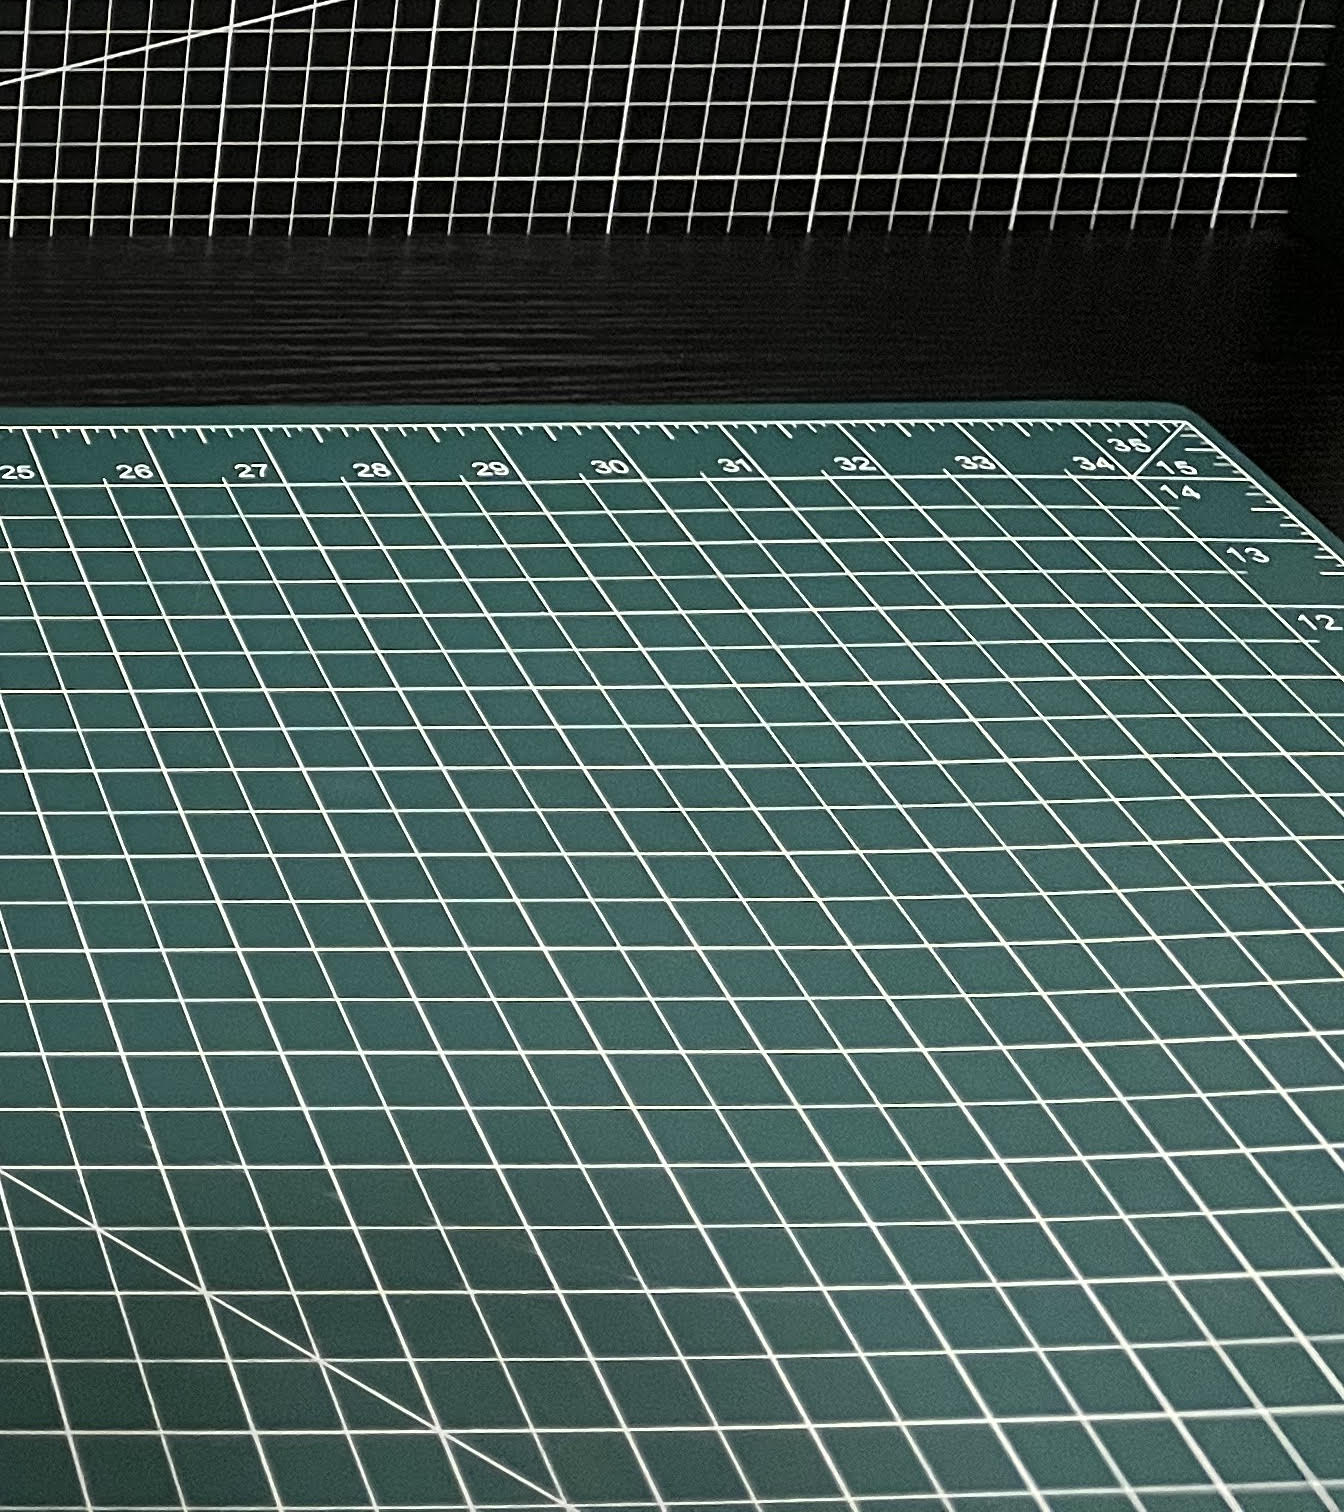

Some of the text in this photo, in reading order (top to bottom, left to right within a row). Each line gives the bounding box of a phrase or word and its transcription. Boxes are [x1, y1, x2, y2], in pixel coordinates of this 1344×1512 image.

[1107, 438, 1152, 454] 35
[234, 463, 268, 478] 27
[352, 462, 392, 478] 28
[471, 461, 510, 476] 29
[590, 459, 630, 474] 30
[717, 458, 753, 473] 31
[833, 456, 878, 472] 32
[954, 455, 997, 471] 33
[1072, 455, 1116, 472] 34
[1155, 460, 1198, 476] 15
[115, 464, 154, 479] 26
[1160, 484, 1201, 500] 14
[1226, 547, 1270, 564] 13
[1297, 614, 1344, 631] 12
